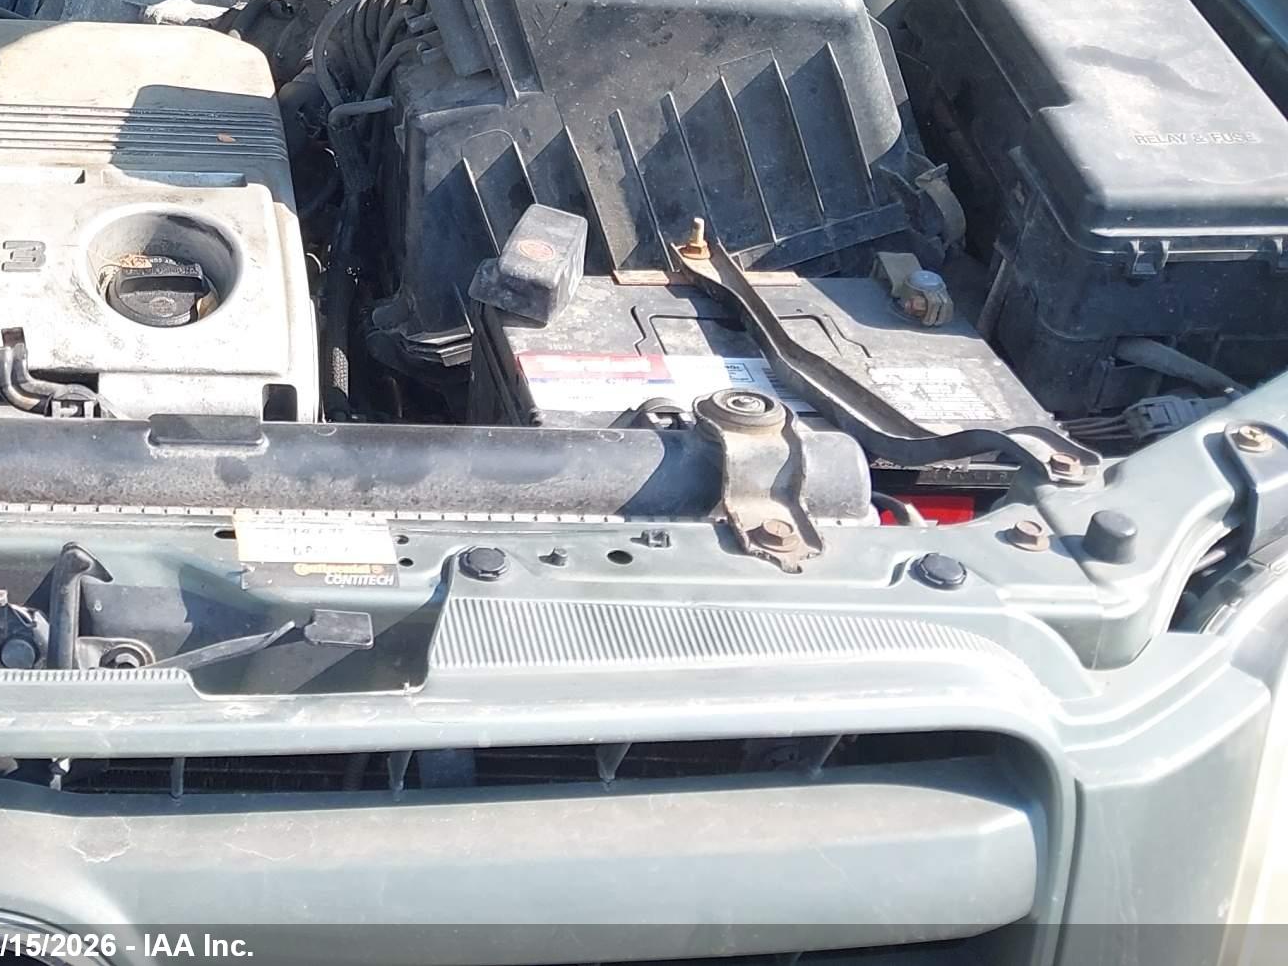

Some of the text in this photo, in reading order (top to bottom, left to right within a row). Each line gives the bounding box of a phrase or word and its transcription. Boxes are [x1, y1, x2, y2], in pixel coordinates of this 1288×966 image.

[1134, 131, 1261, 146] RELAY & FUSE
[324, 573, 395, 586] CONTITECH
